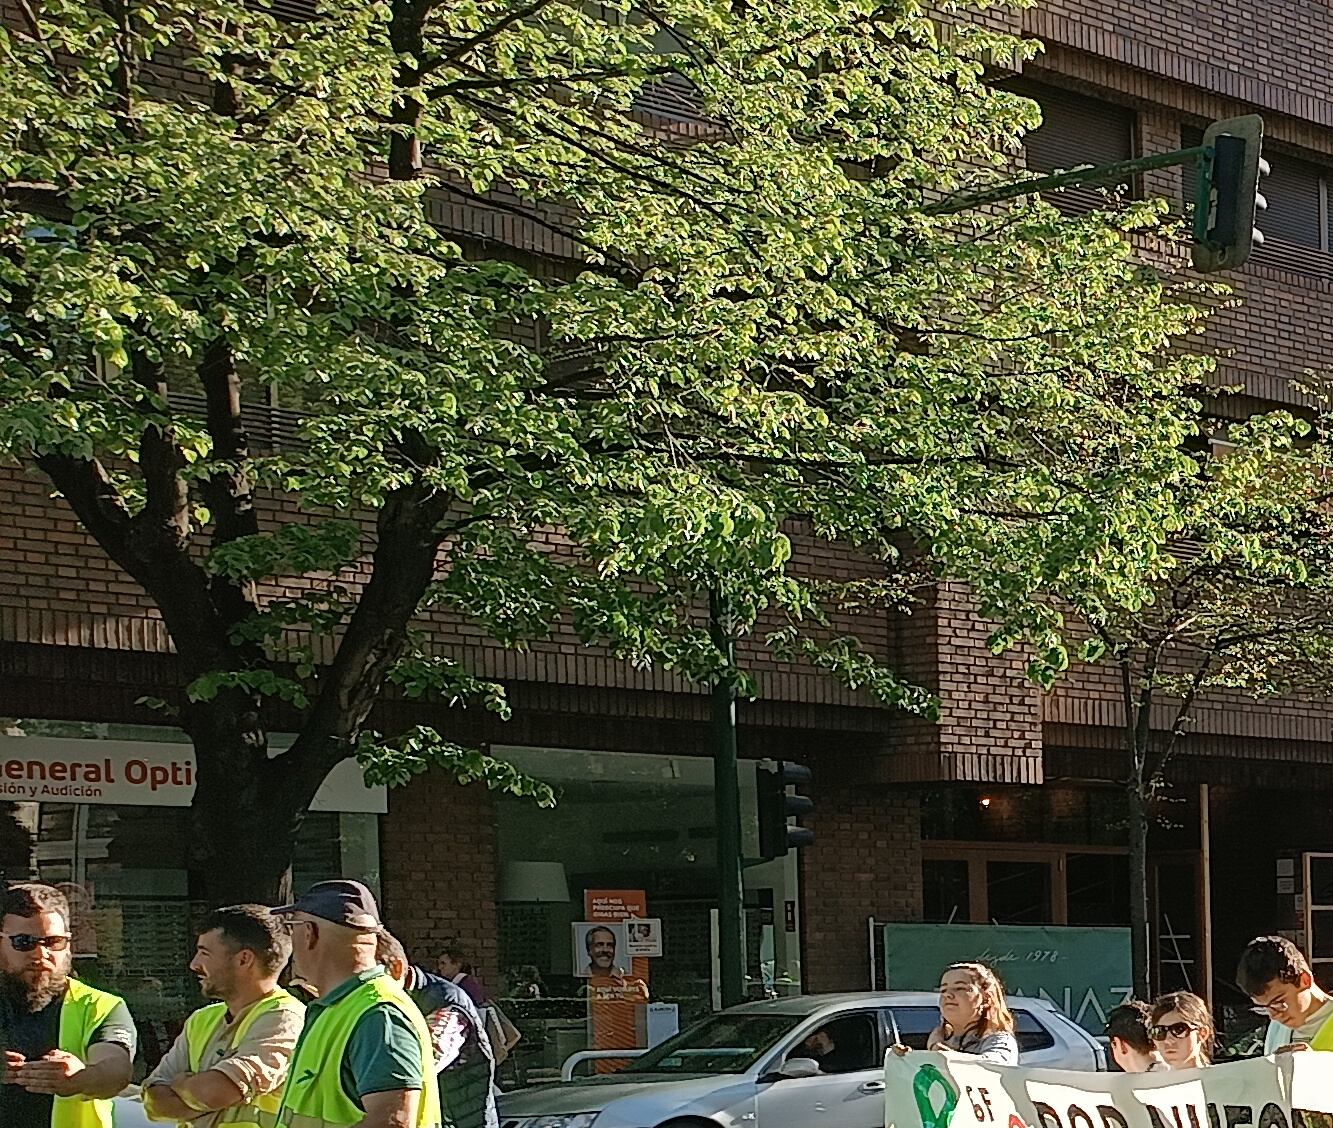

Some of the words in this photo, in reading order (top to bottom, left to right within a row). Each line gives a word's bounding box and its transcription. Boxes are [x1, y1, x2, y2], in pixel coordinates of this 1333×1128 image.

[0, 759, 115, 784] eneral
[29, 786, 38, 798] y
[41, 784, 102, 798] Audición
[1025, 950, 1060, 963] 1978
[966, 1085, 994, 1122] 6F
